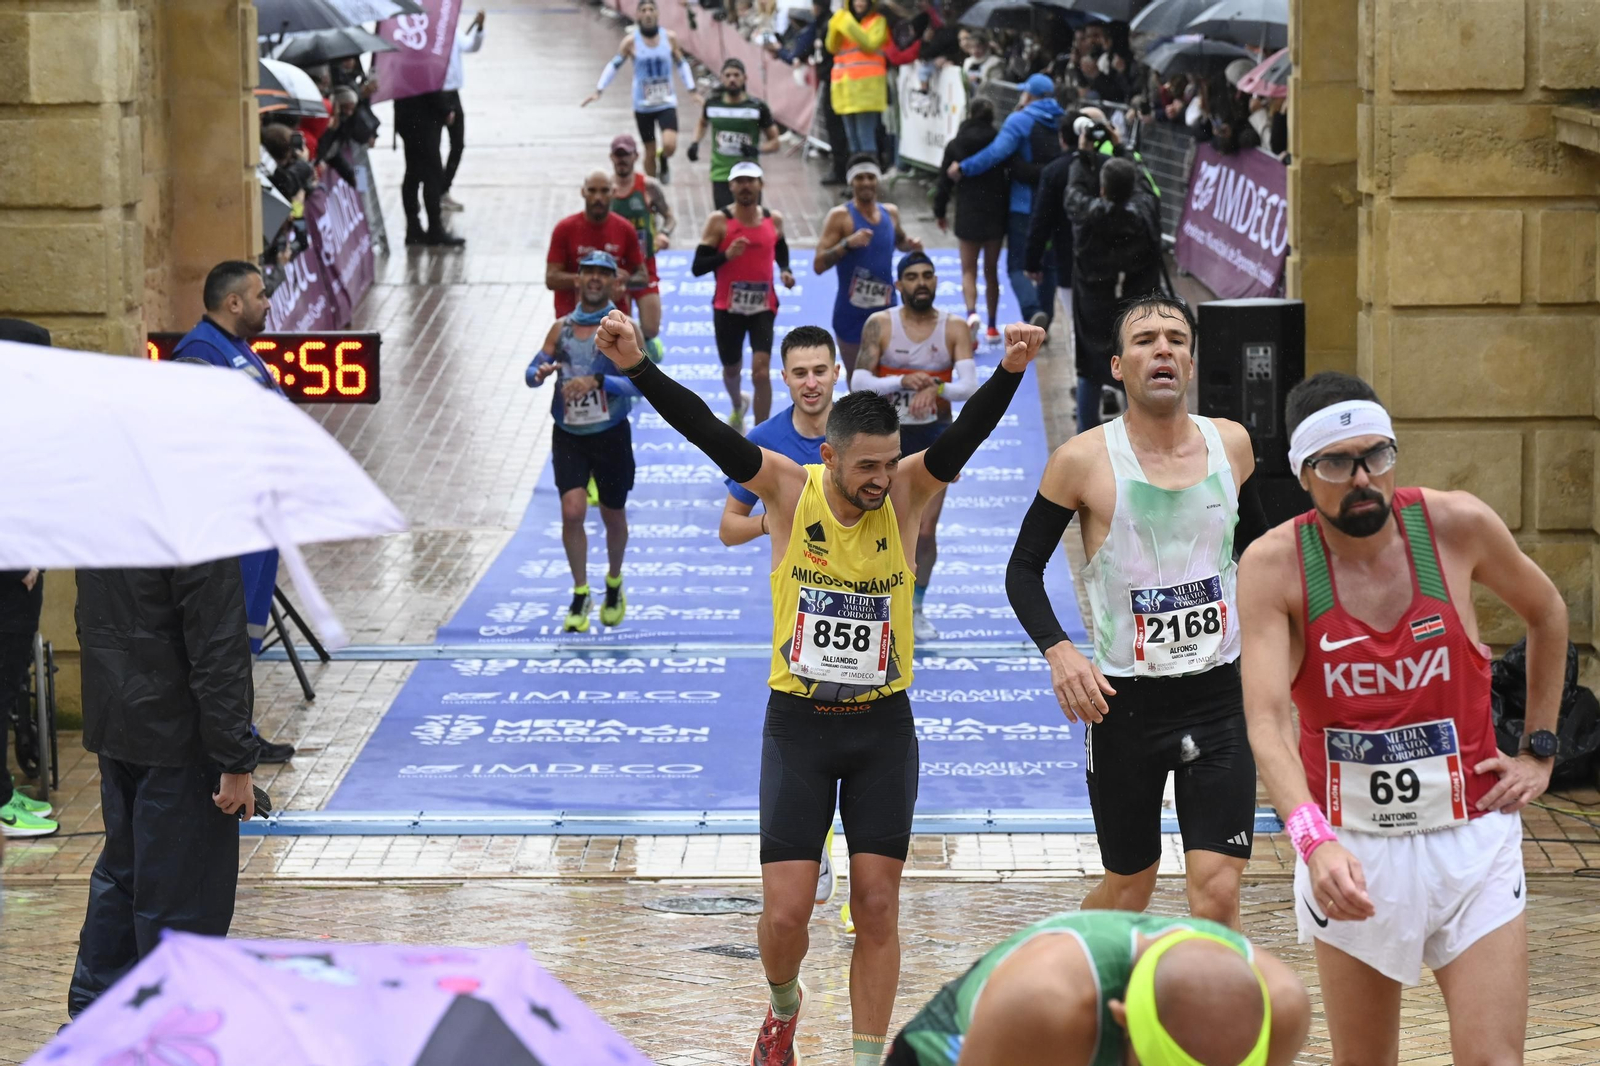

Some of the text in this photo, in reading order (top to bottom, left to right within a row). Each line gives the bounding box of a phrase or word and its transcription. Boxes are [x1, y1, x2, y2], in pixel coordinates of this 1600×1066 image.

[567, 390, 599, 408] 121
[843, 594, 876, 607] MEDIA
[1146, 606, 1221, 644] 2168
[813, 619, 872, 653] 858
[1169, 643, 1198, 655] ALFONSO
[821, 655, 859, 666] ALEJANDRO
[848, 671, 875, 680] IMDECO
[1322, 645, 1451, 698] KENYA
[507, 690, 722, 702] IMDECO
[814, 703, 872, 713] WONG
[495, 718, 628, 728] MEDIA
[914, 717, 985, 727] DIA
[491, 723, 710, 737] MARATÓN
[1384, 727, 1428, 744] MEDIA
[638, 735, 709, 744] 2025
[471, 763, 704, 775] IMDECO
[919, 761, 1079, 770] NTAMIENTO
[1369, 767, 1421, 806] 69
